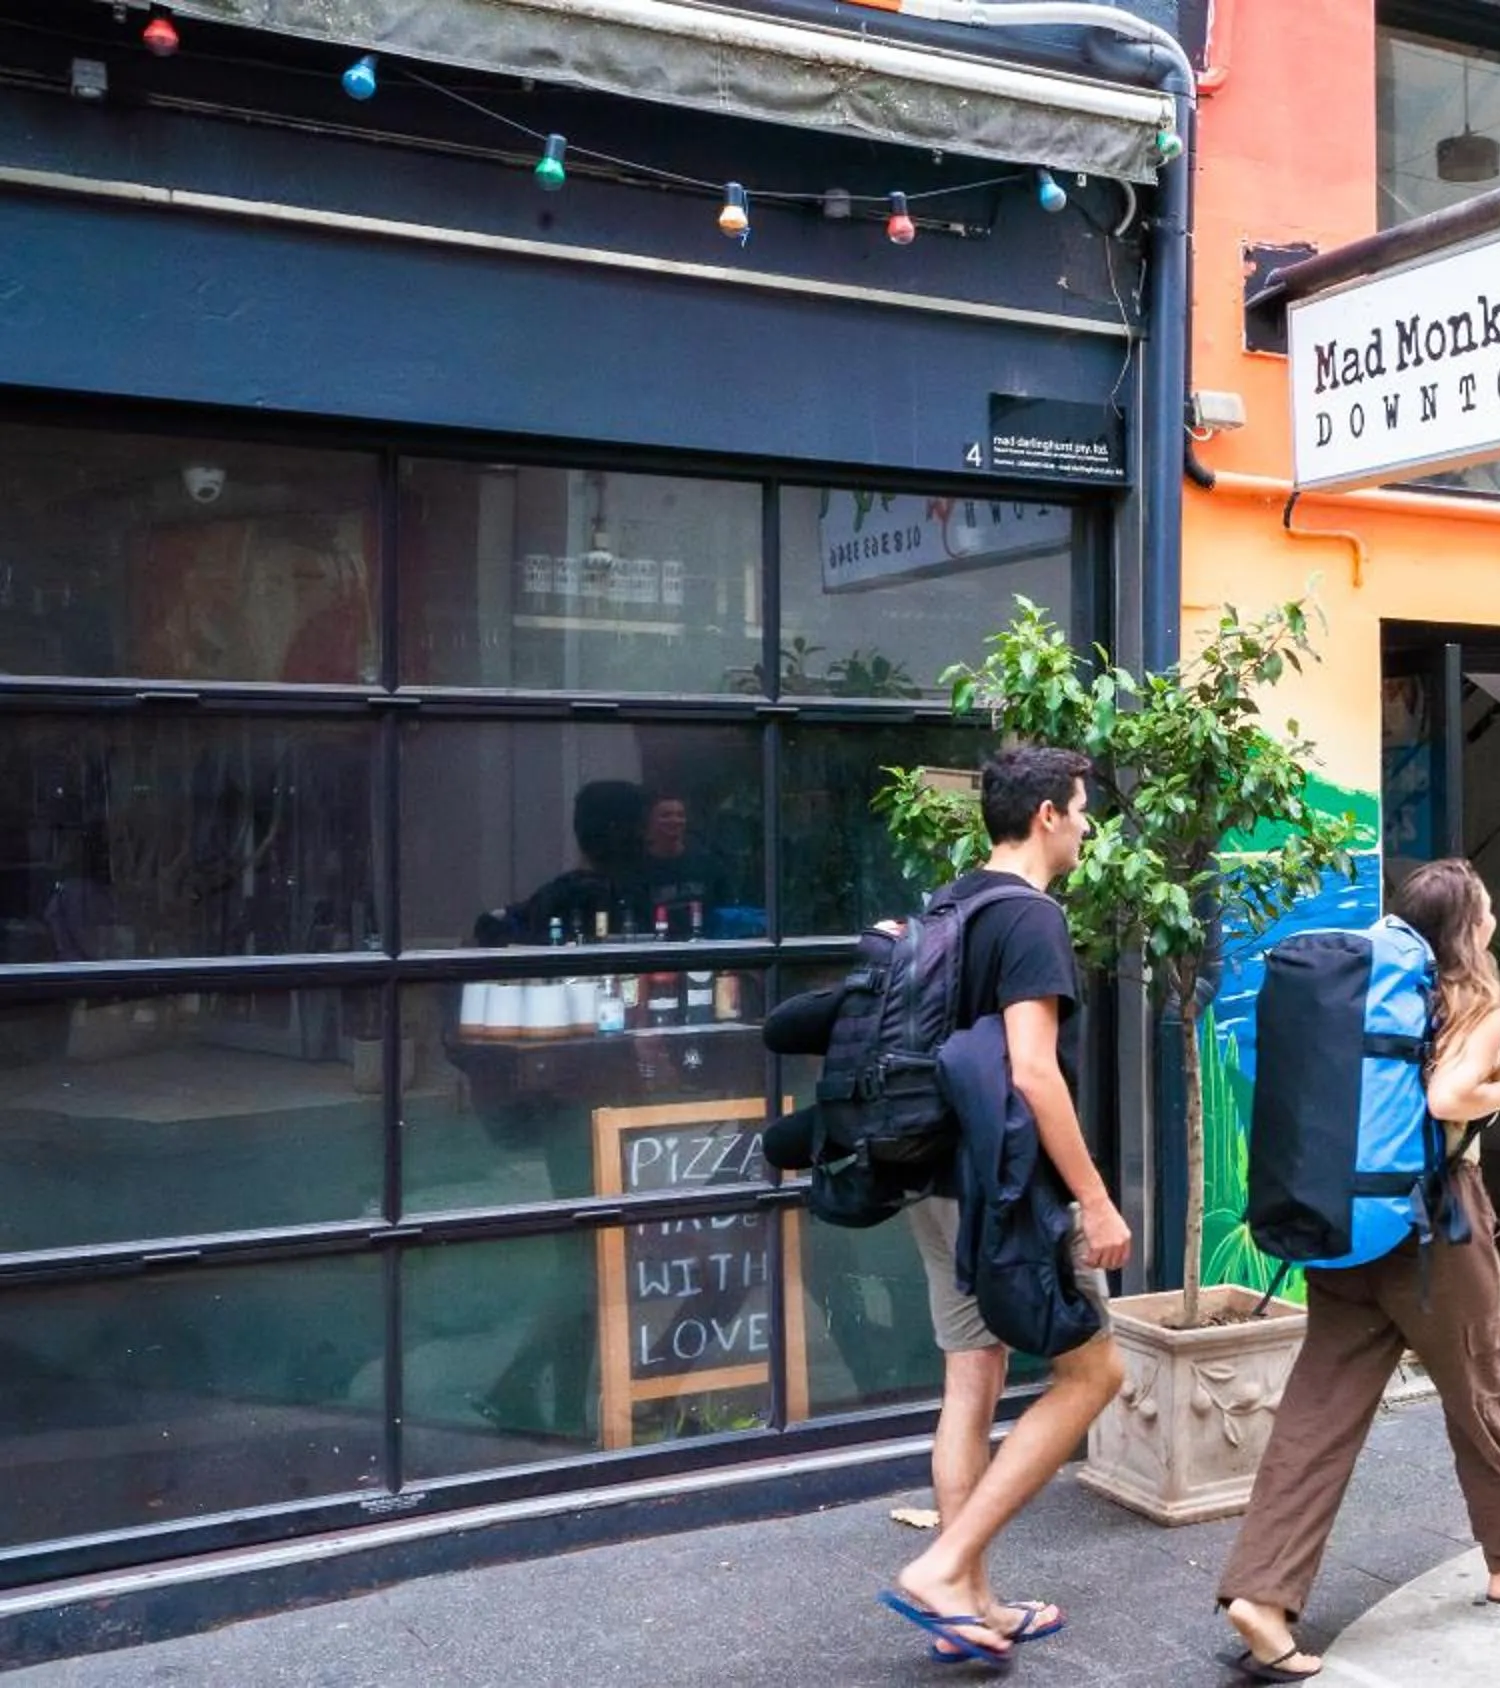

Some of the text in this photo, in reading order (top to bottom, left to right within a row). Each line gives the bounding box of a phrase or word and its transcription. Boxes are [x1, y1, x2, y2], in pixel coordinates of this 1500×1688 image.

[1314, 327, 1387, 395] Mad
[965, 442, 982, 467] 4
[637, 1251, 768, 1297] WITH
[640, 1312, 769, 1366] LOVE
